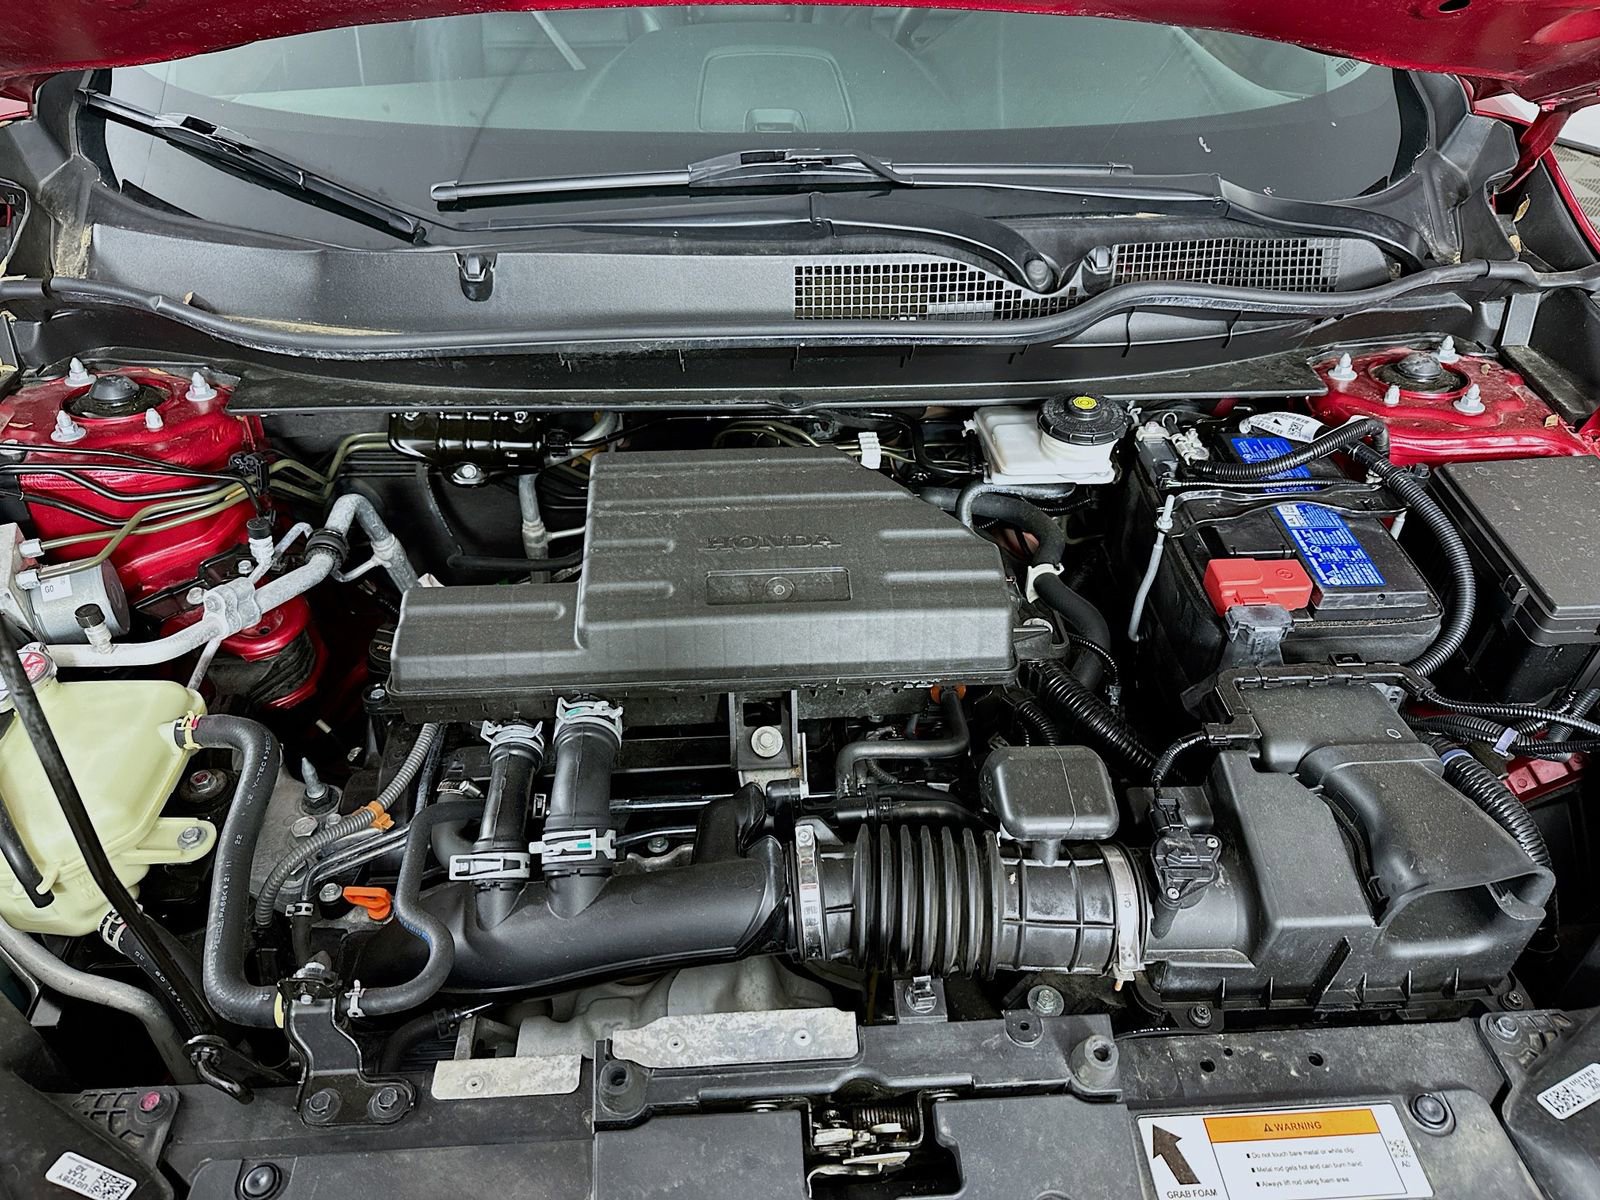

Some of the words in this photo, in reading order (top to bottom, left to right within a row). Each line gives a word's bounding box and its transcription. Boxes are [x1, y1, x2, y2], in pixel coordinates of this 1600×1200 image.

[707, 534, 843, 551] HONDA
[1274, 1121, 1322, 1131] WARNING
[1166, 1190, 1191, 1199] GRAB
[1193, 1188, 1218, 1198] FOAM
